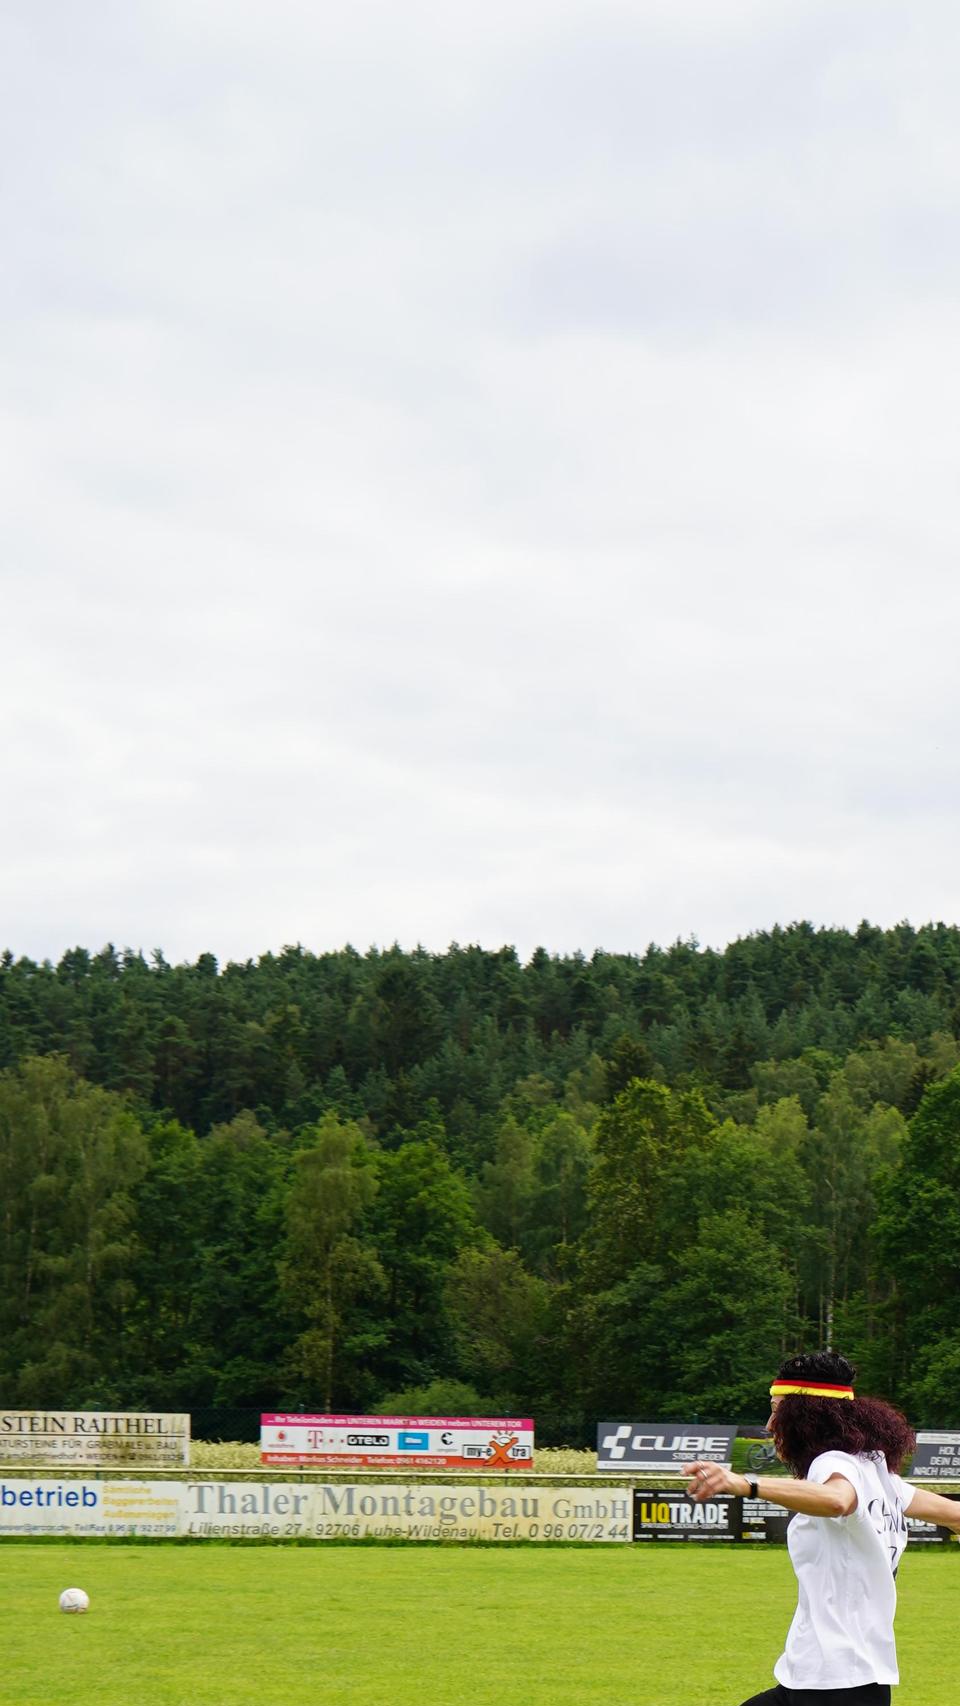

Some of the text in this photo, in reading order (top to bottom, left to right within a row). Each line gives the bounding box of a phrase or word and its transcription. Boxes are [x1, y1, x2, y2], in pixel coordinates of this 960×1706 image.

[73, 1417, 169, 1434] RAITHEL
[631, 1435, 730, 1451] CUBE
[938, 1446, 955, 1456] HOL
[930, 1456, 950, 1466] DEIN
[913, 1467, 938, 1476] NACH
[2, 1485, 97, 1506] betrieb
[187, 1485, 629, 1525] Thaler Montagebau GmbH
[640, 1502, 729, 1524] LIQTRADE
[188, 1522, 279, 1535] Lilienstraße
[285, 1523, 302, 1535] 27
[315, 1524, 360, 1536] 92706
[364, 1524, 477, 1538] Luhe-Wildenau
[492, 1523, 521, 1538] Tel.
